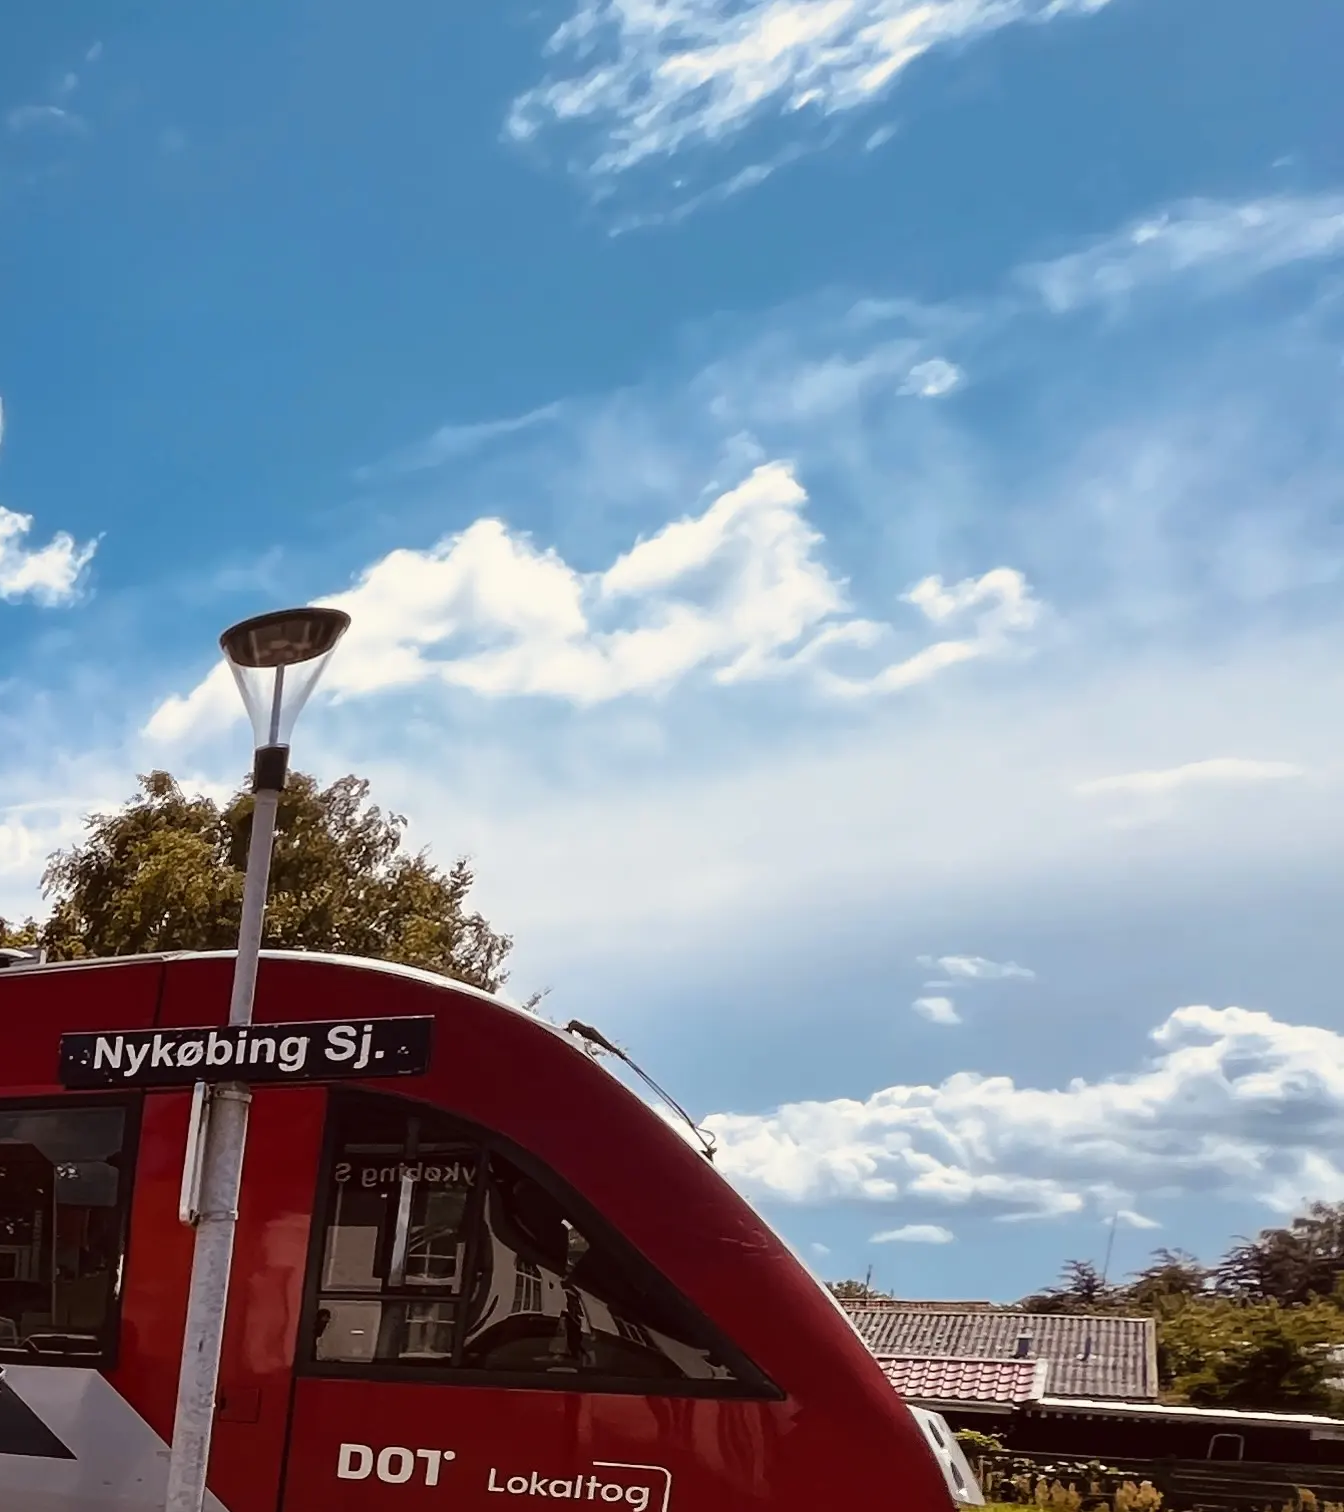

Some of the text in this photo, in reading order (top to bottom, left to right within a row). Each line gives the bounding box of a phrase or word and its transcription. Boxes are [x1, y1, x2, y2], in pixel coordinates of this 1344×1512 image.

[93, 1024, 385, 1076] Nykøbing Sj.
[337, 1443, 442, 1486] DOT
[487, 1467, 650, 1512] Lokaltog
